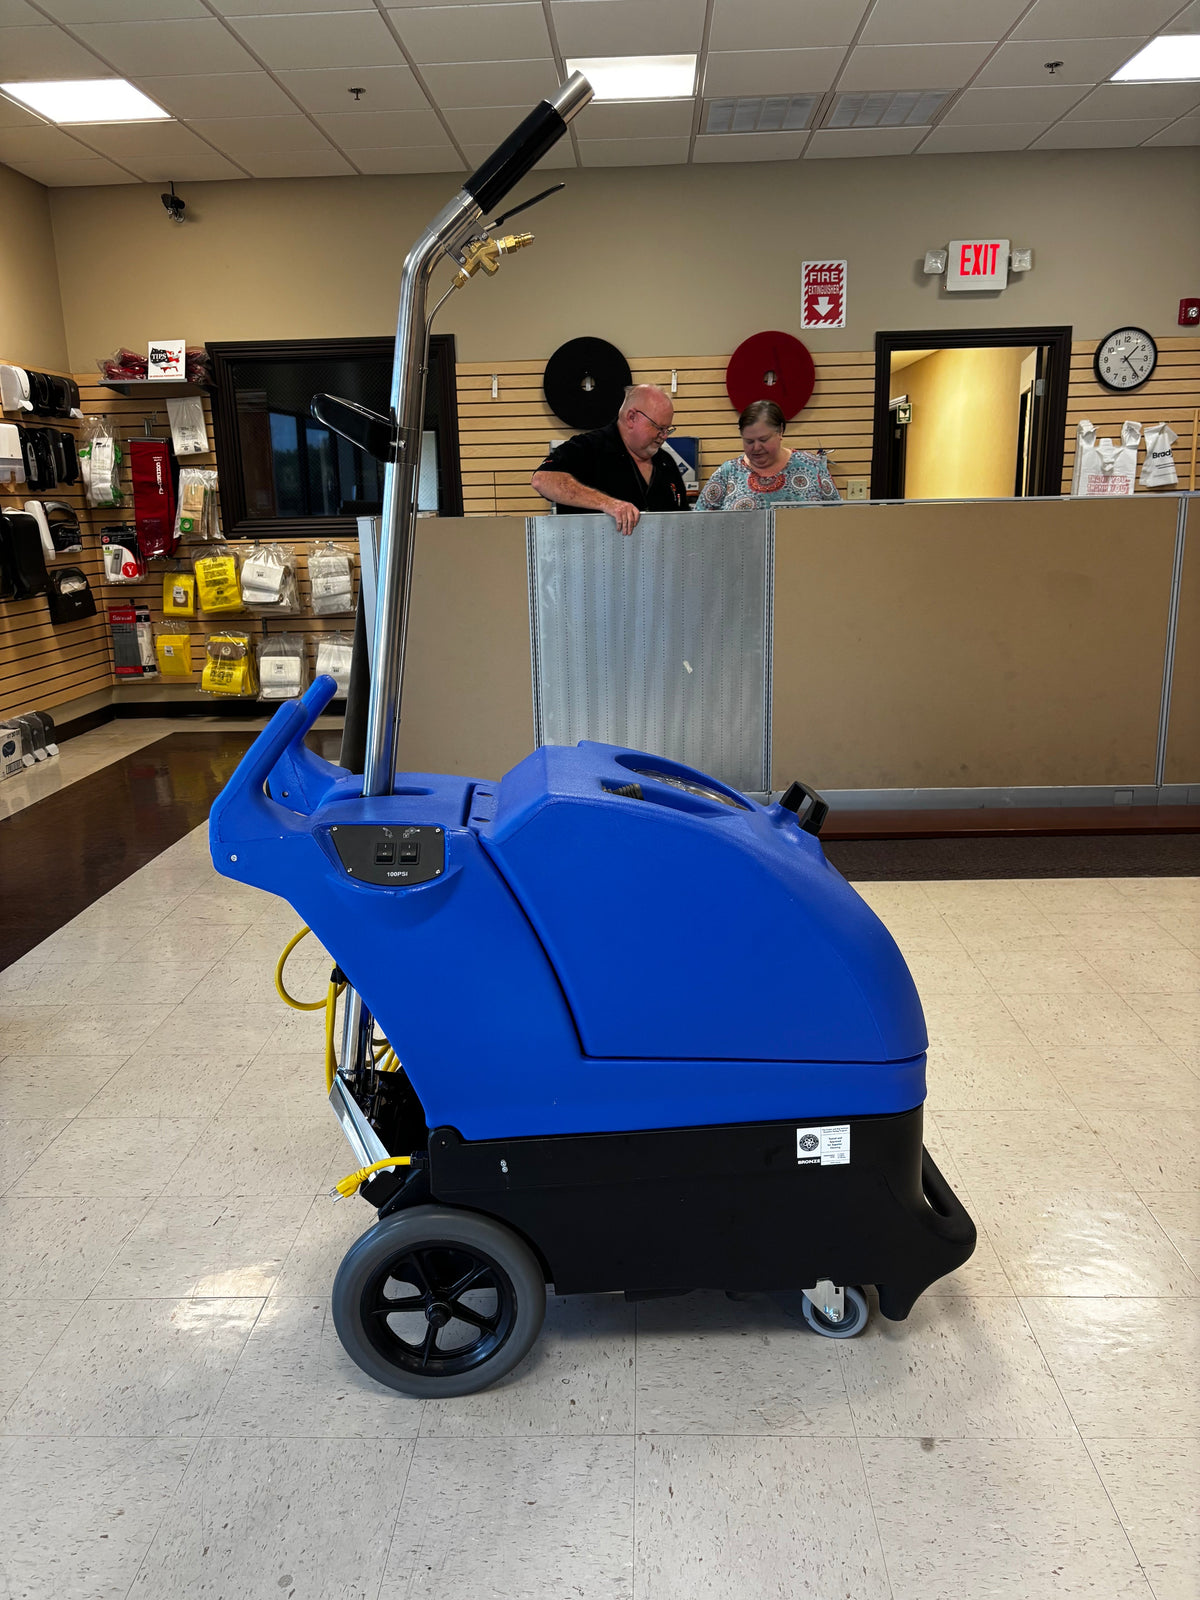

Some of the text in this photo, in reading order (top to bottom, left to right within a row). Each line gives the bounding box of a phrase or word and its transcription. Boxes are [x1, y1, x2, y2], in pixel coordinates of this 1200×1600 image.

[960, 243, 1000, 276] EXIT
[810, 271, 839, 283] FIRE
[808, 284, 840, 295] EXTINGUISHER
[1124, 335, 1131, 343] 12
[1107, 346, 1115, 354] 10
[151, 352, 168, 360] TIPS
[1113, 372, 1118, 380] 7
[1152, 449, 1173, 459] Brad
[126, 565, 134, 576] Y
